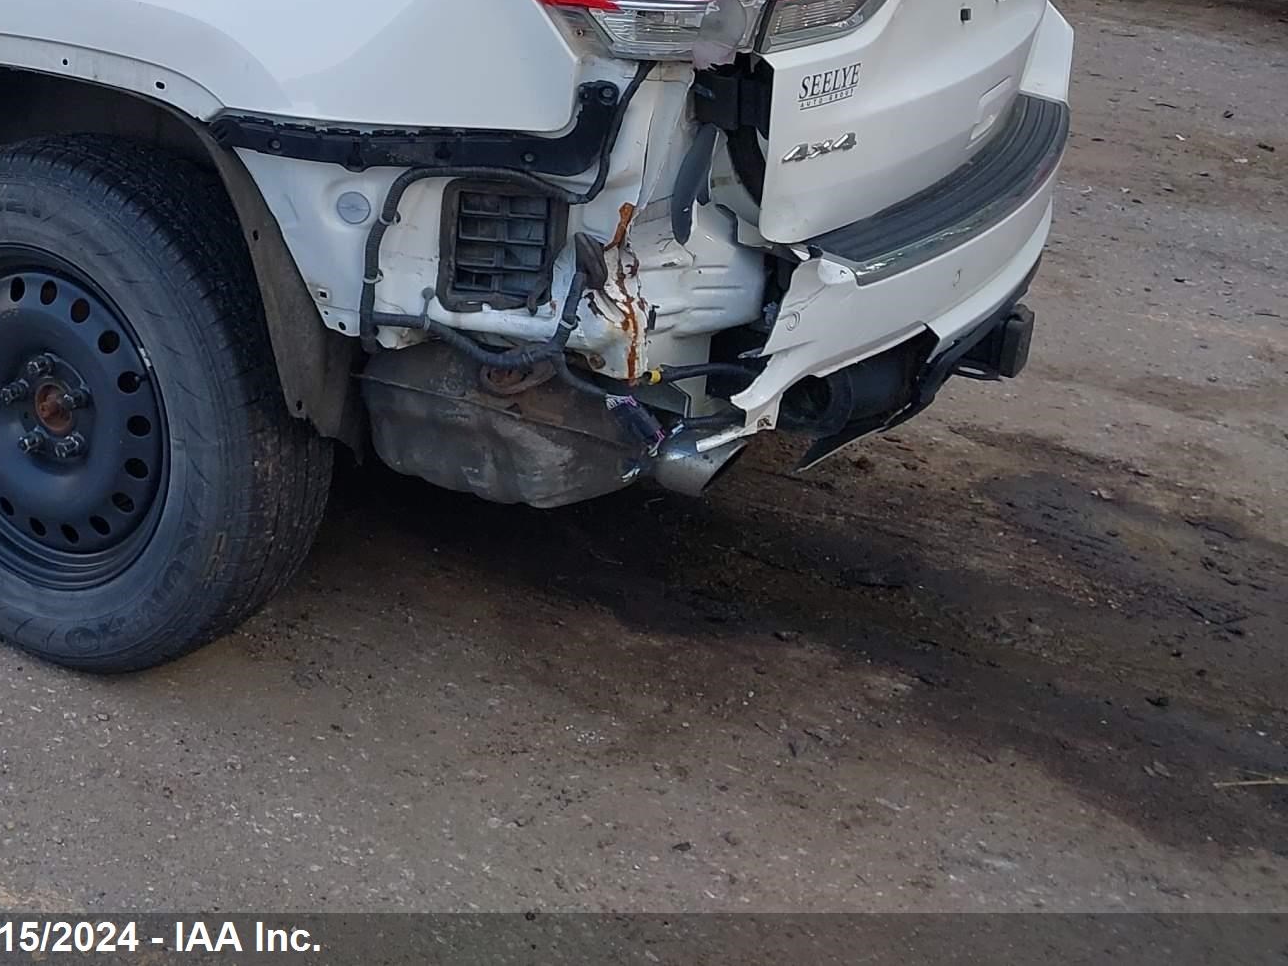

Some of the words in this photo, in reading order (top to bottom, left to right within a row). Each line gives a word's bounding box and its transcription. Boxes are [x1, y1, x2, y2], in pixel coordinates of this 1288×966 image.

[798, 62, 862, 100] SEELYE
[800, 95, 823, 108] AUTO
[781, 132, 857, 164] 4x4
